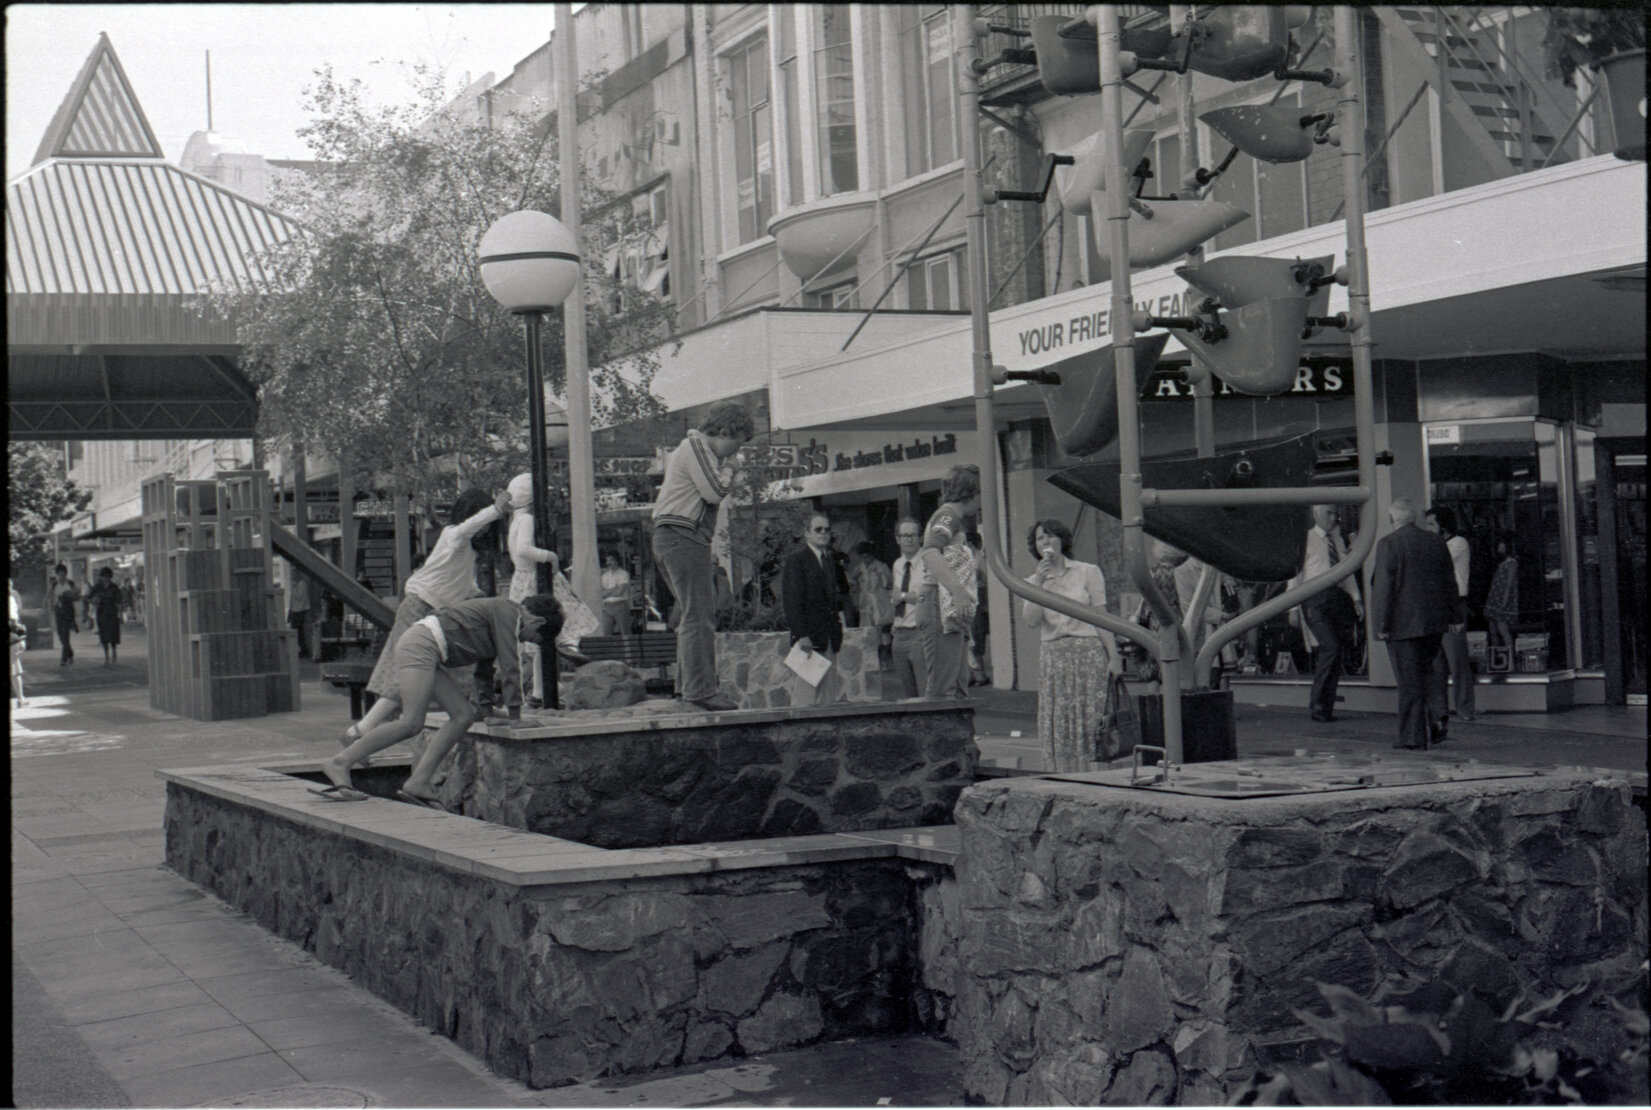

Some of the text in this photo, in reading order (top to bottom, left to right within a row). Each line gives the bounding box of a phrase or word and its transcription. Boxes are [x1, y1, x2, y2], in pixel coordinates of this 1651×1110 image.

[1019, 322, 1064, 356] YOUR
[1069, 299, 1154, 344] FRIEY
[883, 443, 904, 463] that
[905, 438, 932, 460] value
[932, 433, 957, 456] built
[940, 515, 952, 525] 12
